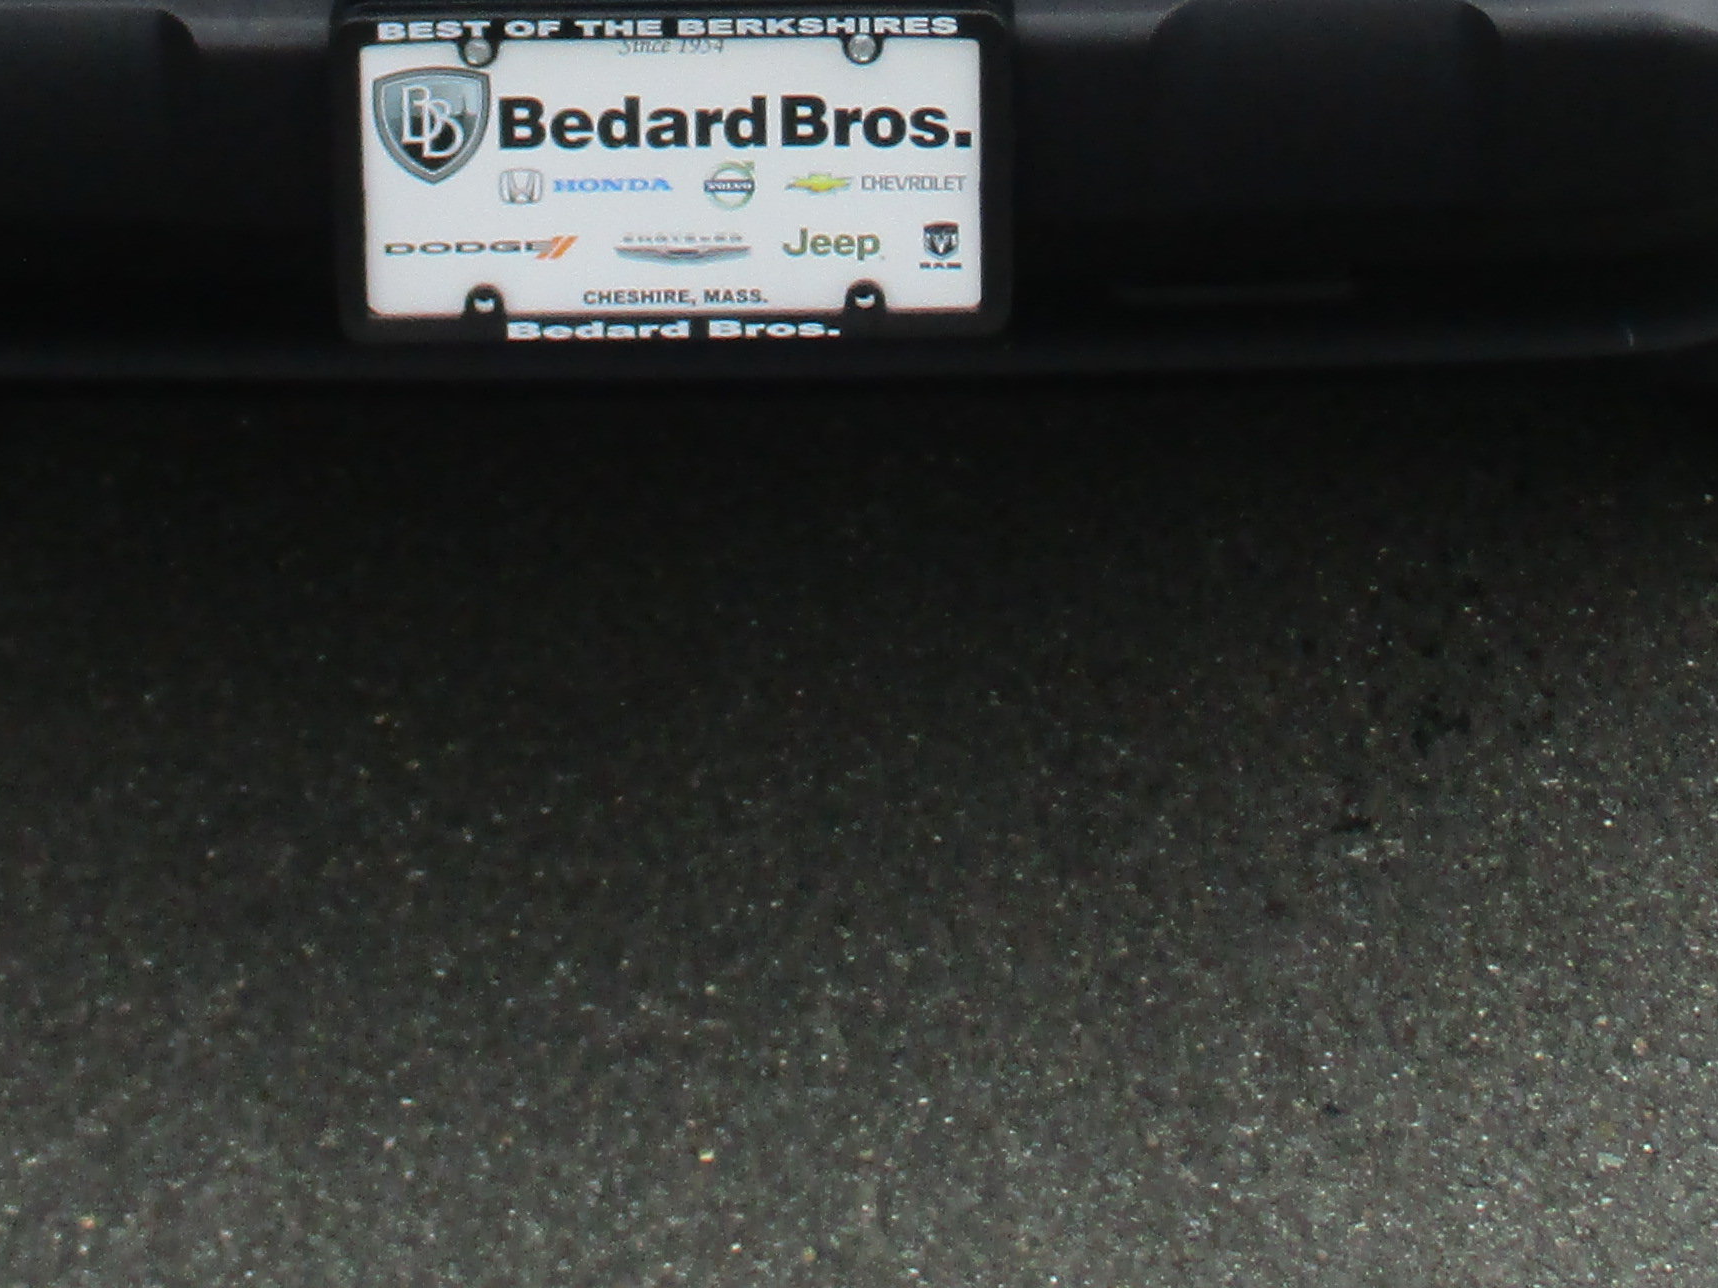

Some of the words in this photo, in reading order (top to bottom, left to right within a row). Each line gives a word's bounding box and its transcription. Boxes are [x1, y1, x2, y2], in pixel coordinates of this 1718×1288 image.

[377, 21, 490, 40] BEST
[504, 20, 561, 38] OF
[575, 19, 663, 37] THE
[677, 17, 959, 36] BERKSHIRES
[618, 37, 672, 56] Since
[498, 95, 767, 149] Bedard
[780, 95, 972, 148] Bros.
[553, 178, 674, 192] HONDA
[861, 174, 967, 191] CHEVROLET
[385, 240, 554, 255] DODGE
[782, 227, 881, 261] Jeep
[583, 289, 696, 305] CHESHIRE,
[703, 288, 768, 304] MASS.
[506, 320, 690, 340] Bedard
[708, 319, 841, 339] Bros.
